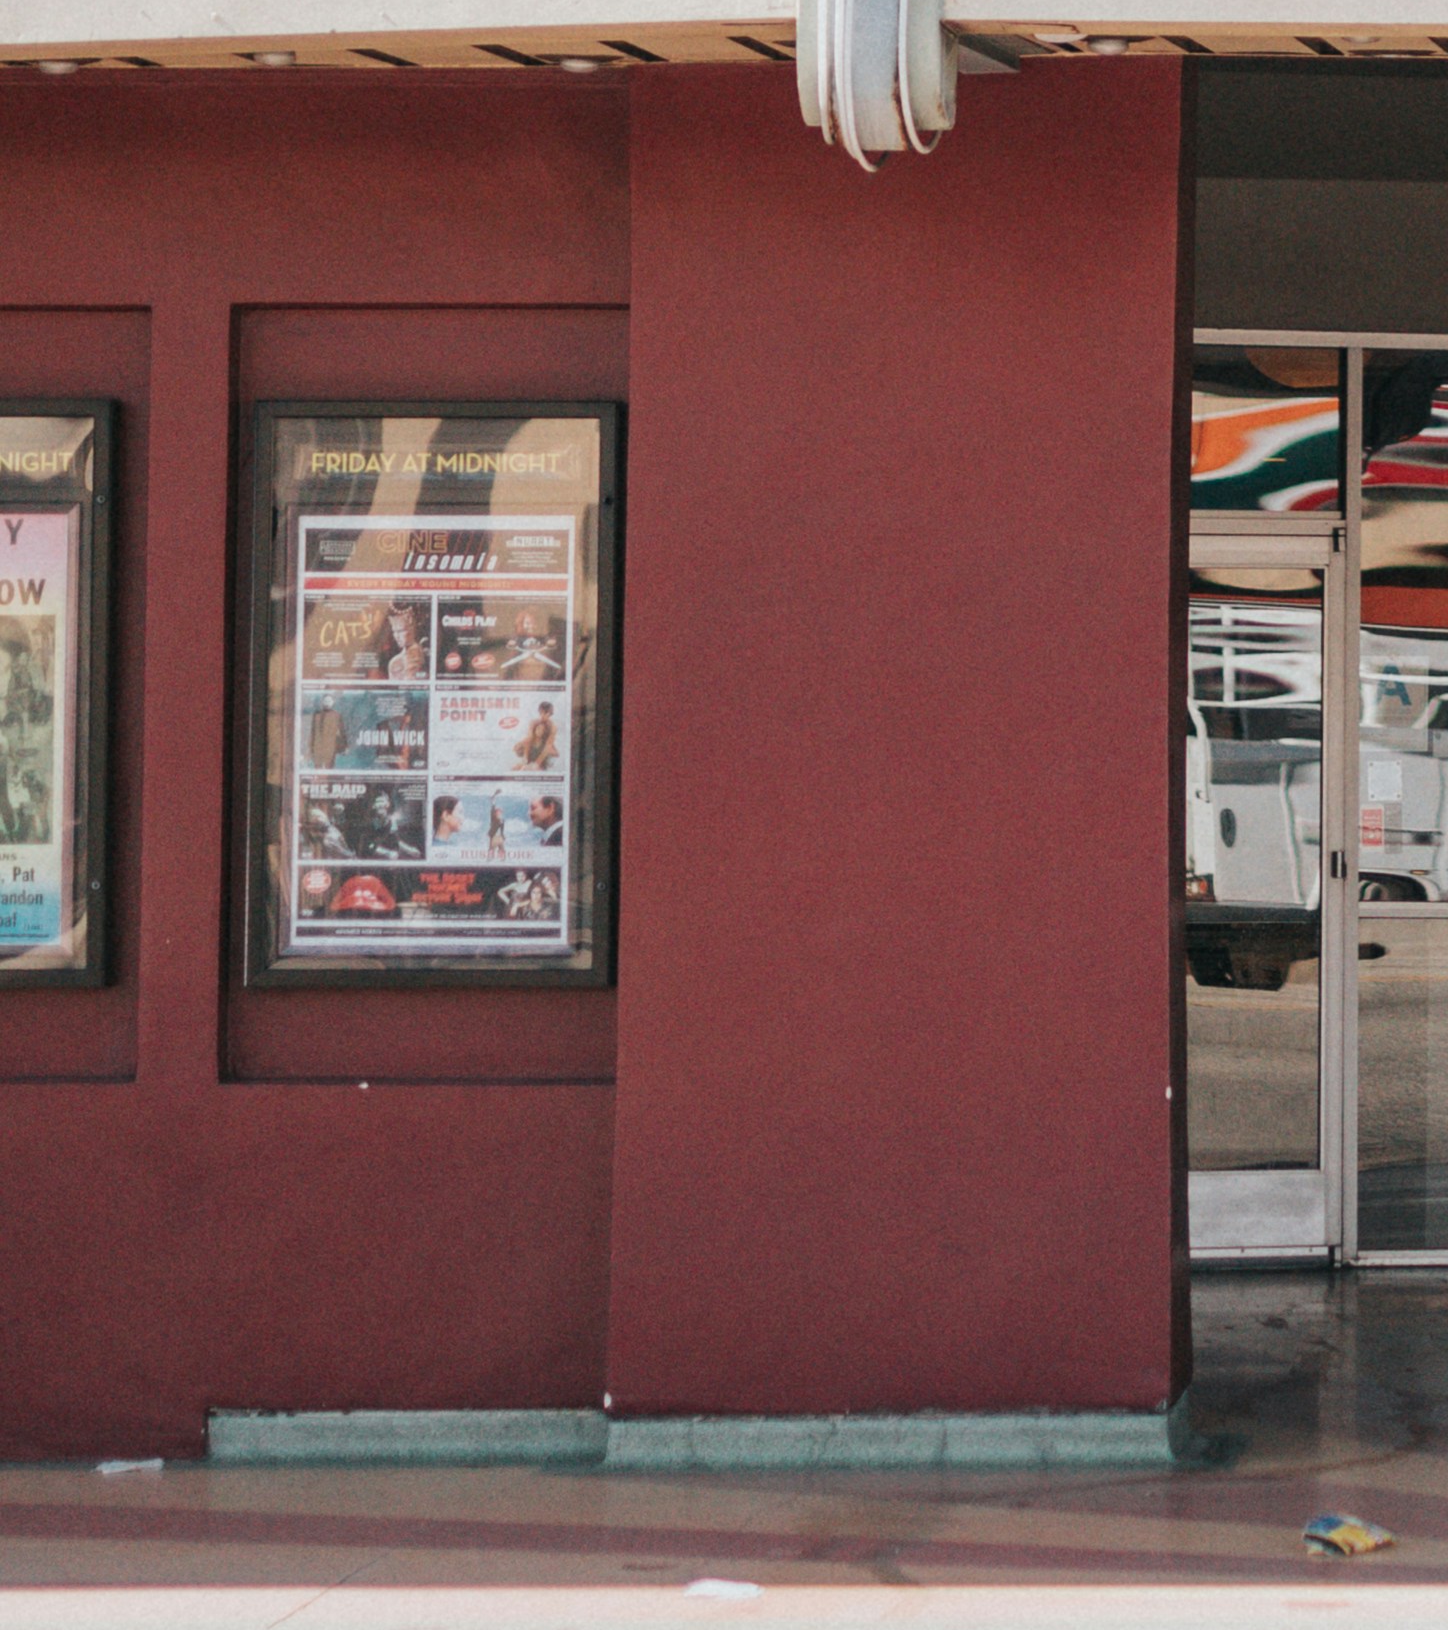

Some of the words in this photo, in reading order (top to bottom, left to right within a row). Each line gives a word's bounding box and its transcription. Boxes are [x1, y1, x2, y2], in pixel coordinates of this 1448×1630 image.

[311, 452, 397, 473] FRIDAY
[401, 452, 429, 473] AT
[436, 452, 561, 474] MIDNIGHT
[376, 529, 448, 554] CINE
[403, 550, 498, 571] insomnia
[439, 710, 487, 722] POINT
[357, 730, 389, 746] JOHN
[392, 730, 425, 746] WICK
[12, 866, 36, 882] Pat
